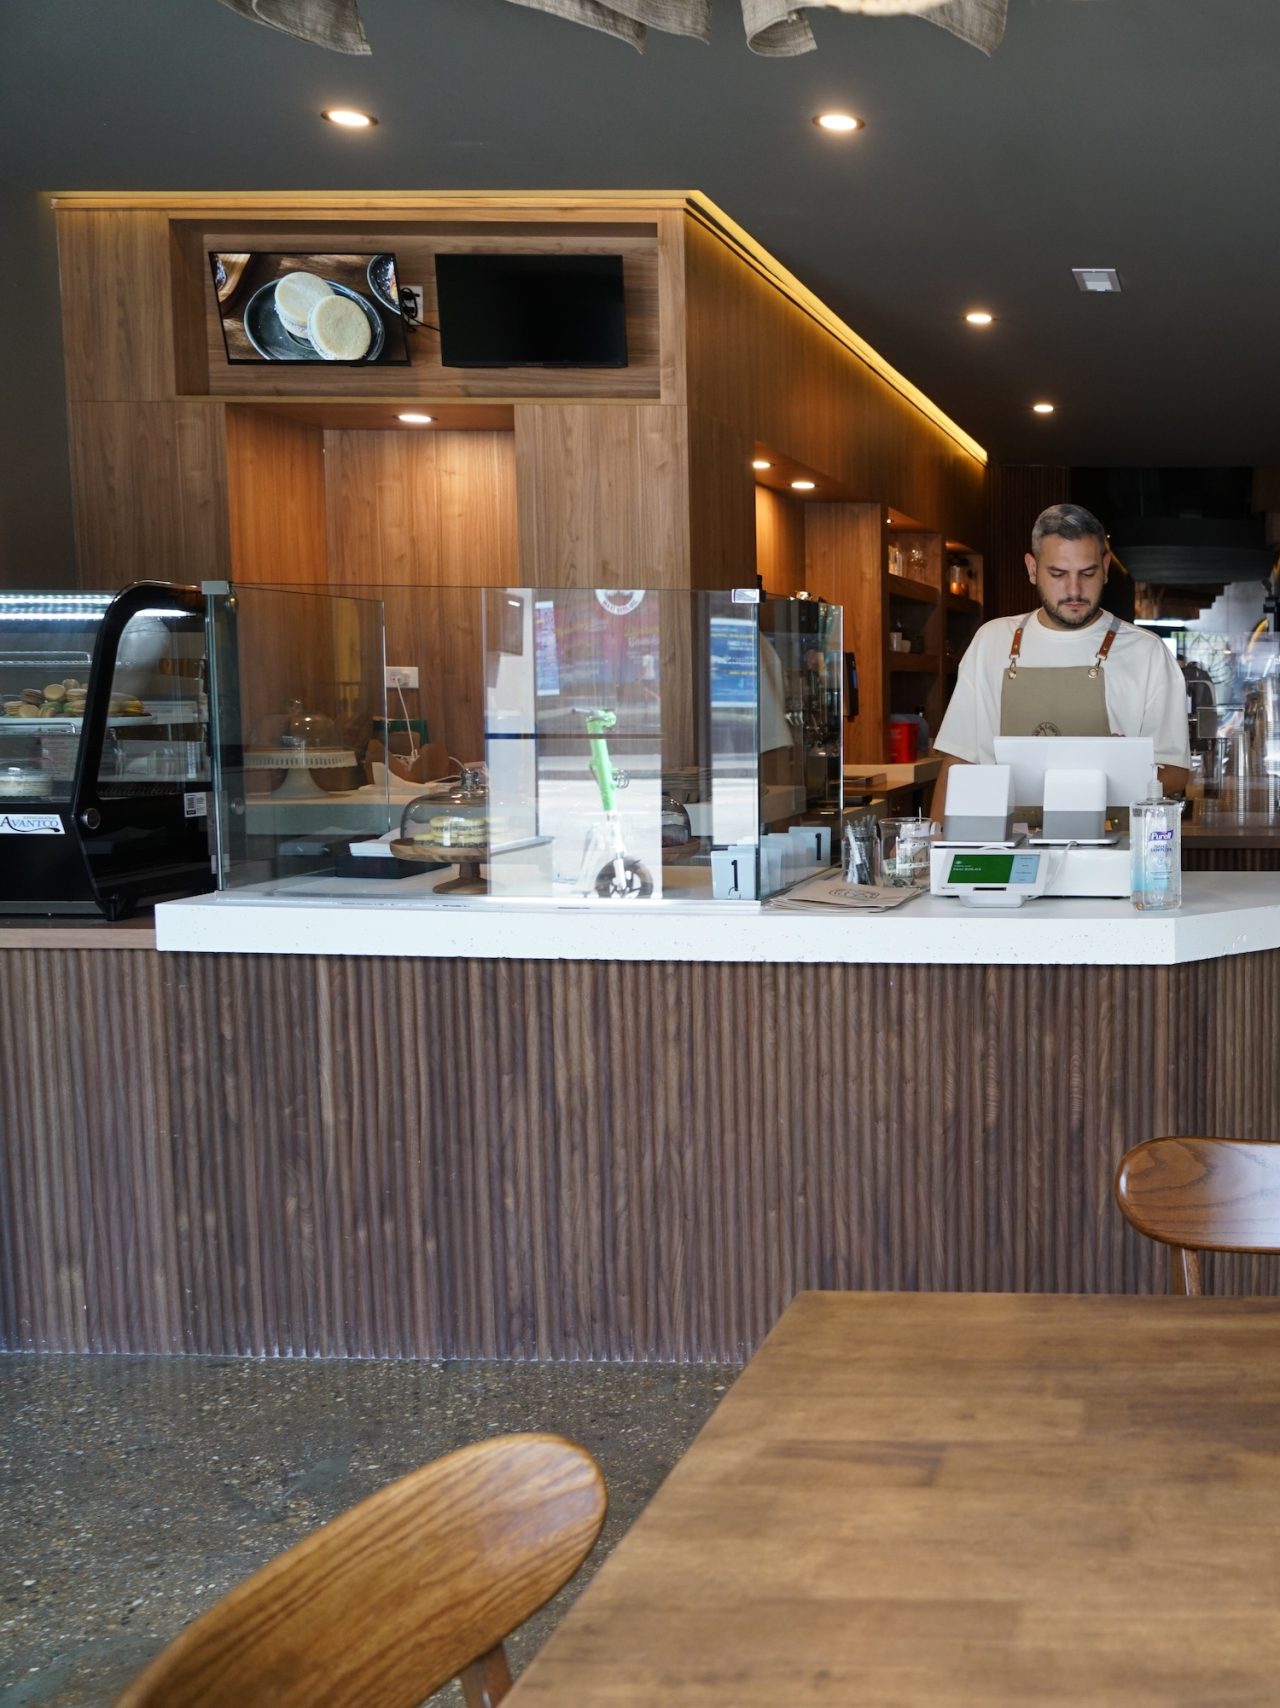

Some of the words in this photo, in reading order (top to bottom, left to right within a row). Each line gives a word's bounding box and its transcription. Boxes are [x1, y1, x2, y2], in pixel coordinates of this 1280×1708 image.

[0, 816, 60, 832] AVANTCO
[815, 833, 821, 860] 1
[731, 860, 738, 891] 1
